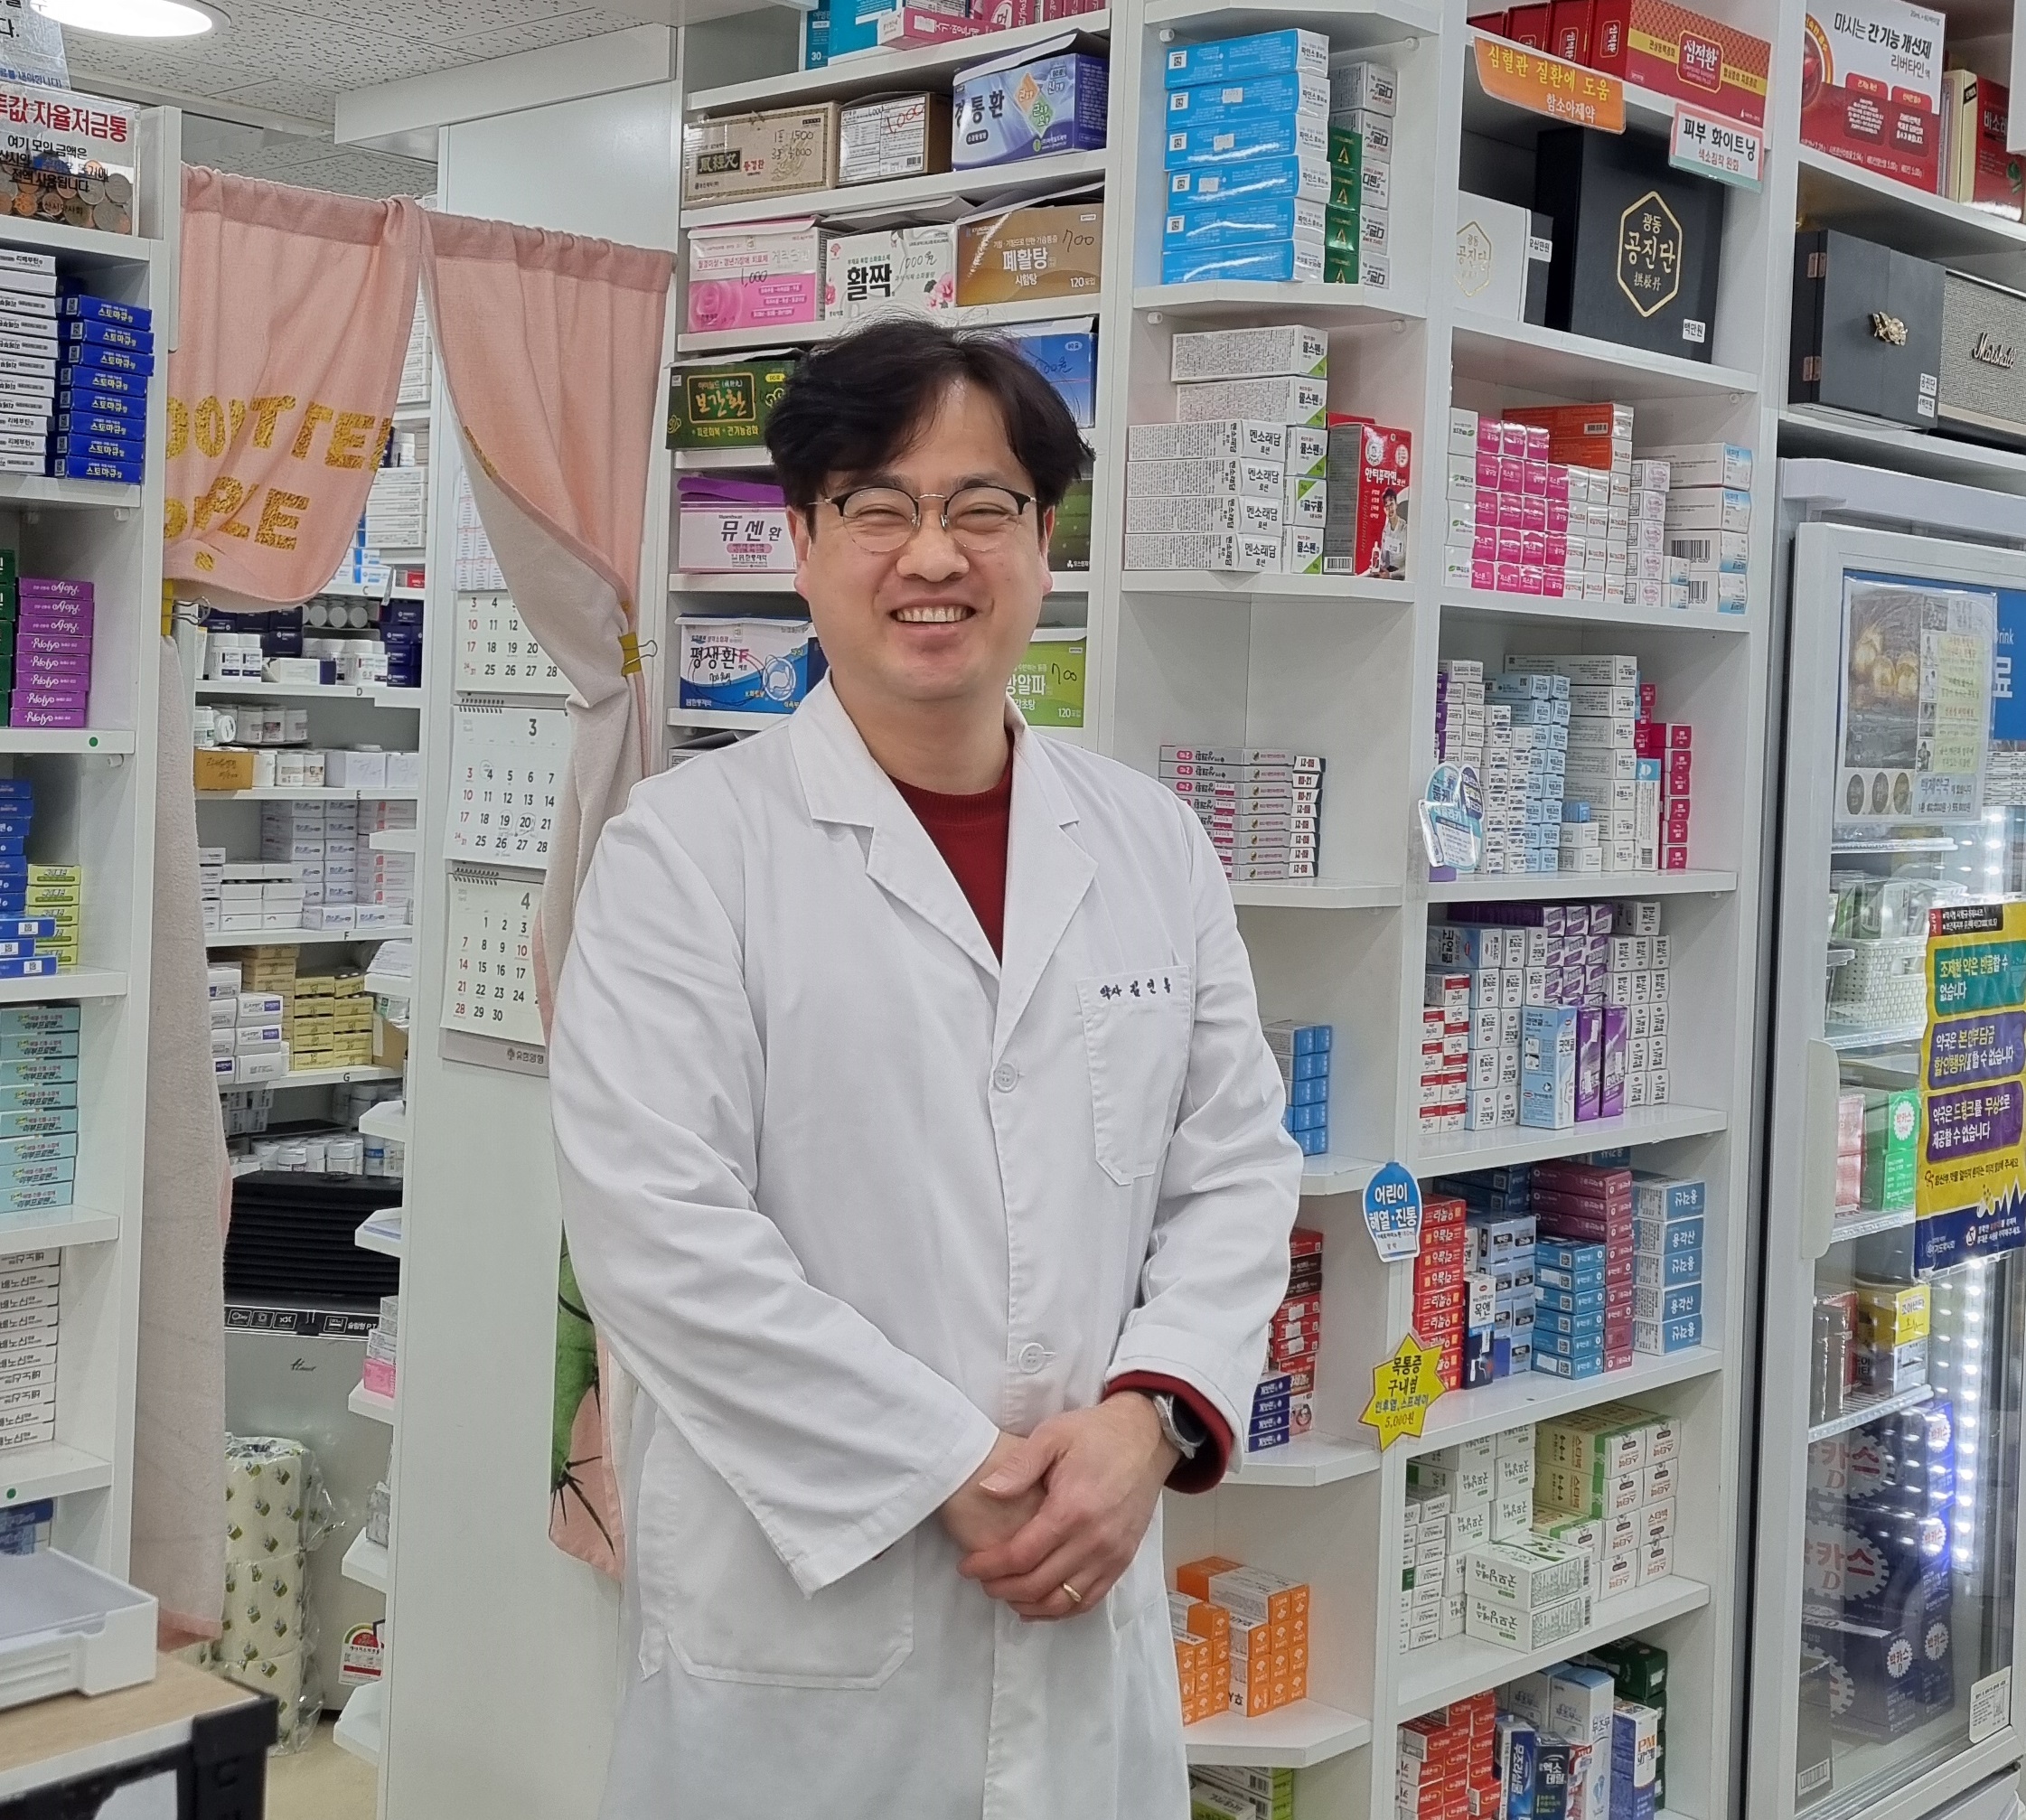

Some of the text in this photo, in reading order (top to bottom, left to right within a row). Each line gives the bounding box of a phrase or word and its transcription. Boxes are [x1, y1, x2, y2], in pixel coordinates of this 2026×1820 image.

[1834, 13, 1866, 40] 마시는
[1902, 33, 1933, 60] 개선제
[811, 52, 821, 61] 30
[1684, 39, 1718, 70] 심적환
[1487, 47, 1610, 102] 심혈관 질환에 도움
[1890, 54, 1925, 78] 리버타인
[1546, 92, 1596, 122] 함소아제약
[33, 99, 127, 143] 자율저금통
[8, 135, 88, 159] 여기 모인 금액은
[1684, 118, 1756, 162] 피부 화이트닝
[1643, 212, 1662, 234] 광동
[1002, 247, 1048, 271] 폐활탕
[1457, 245, 1488, 270] 공진단
[1624, 230, 1676, 274] 공진단
[847, 263, 893, 302] 활짝
[1684, 322, 1703, 337] 백만원
[1973, 332, 2016, 369] Marshall
[362, 586, 369, 596] C
[471, 597, 498, 608] 3 4
[468, 619, 518, 631] 10 11 12
[467, 642, 539, 653] 17 18 19 20
[484, 664, 558, 677] 25 26 27 28
[356, 688, 362, 697] D
[529, 718, 537, 736] 3
[467, 767, 555, 784] 3 4 5 6 7
[356, 791, 361, 800] E
[463, 790, 555, 807] 10 11 12 13 14
[460, 811, 551, 830] 17 18 19 20 21
[475, 835, 548, 853] 25 26 27 28
[521, 892, 530, 910] 4
[483, 917, 527, 933] 1 2 3
[344, 932, 351, 941] F
[463, 936, 528, 957] 7 8 9 10
[459, 958, 526, 980] 14 15 16 17
[1940, 959, 1962, 978] 조제한
[1963, 957, 1978, 976] 약은
[2002, 954, 2008, 972] 수
[457, 980, 524, 1002] 21 22 23 24
[1940, 981, 1966, 1002] 없습니다
[455, 1003, 502, 1021] 28 29 30
[1937, 1026, 1995, 1051] 약국은 본인부담금
[1980, 1051, 1988, 1067] 수
[1988, 1045, 2014, 1066] 없습니다
[343, 1073, 351, 1083] G
[1933, 1094, 2011, 1125] 약국은 드링크를 무상으로
[1932, 1121, 1991, 1149] 제공할 수 없습니다
[1375, 1184, 1408, 1203] 어린이
[1392, 1356, 1421, 1374] 목통증
[1388, 1376, 1419, 1397] 구내염
[1384, 1411, 1414, 1428] 5,000원
[1827, 1469, 1845, 1489] D
[1823, 1570, 1841, 1590] D
[1637, 1736, 1656, 1751] PM
